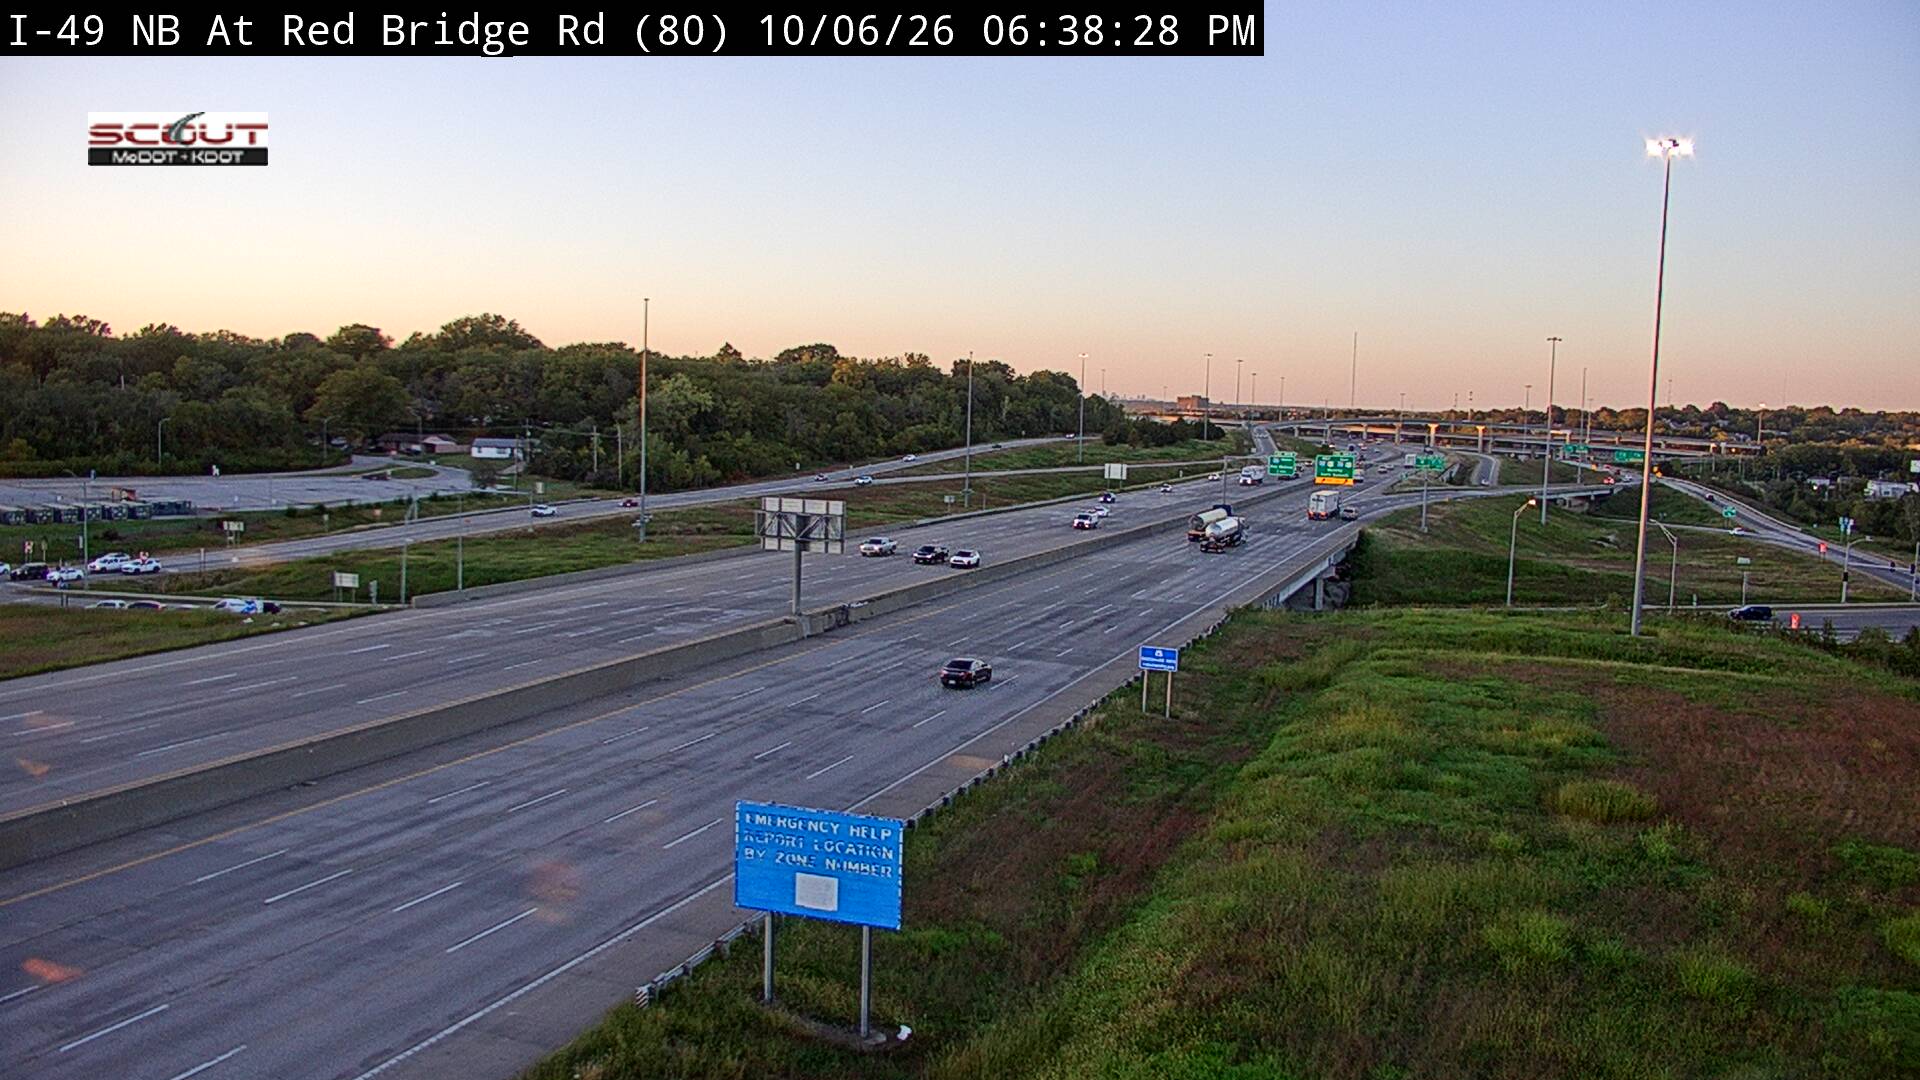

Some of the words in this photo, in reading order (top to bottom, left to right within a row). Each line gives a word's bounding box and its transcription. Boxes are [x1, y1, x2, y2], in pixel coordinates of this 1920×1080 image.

[745, 813, 840, 835] EMERGENCY
[850, 825, 892, 841] HELP
[744, 830, 805, 849] REPORT
[813, 839, 894, 860] LOCATION
[744, 847, 766, 861] BY
[775, 851, 816, 868] ZONE
